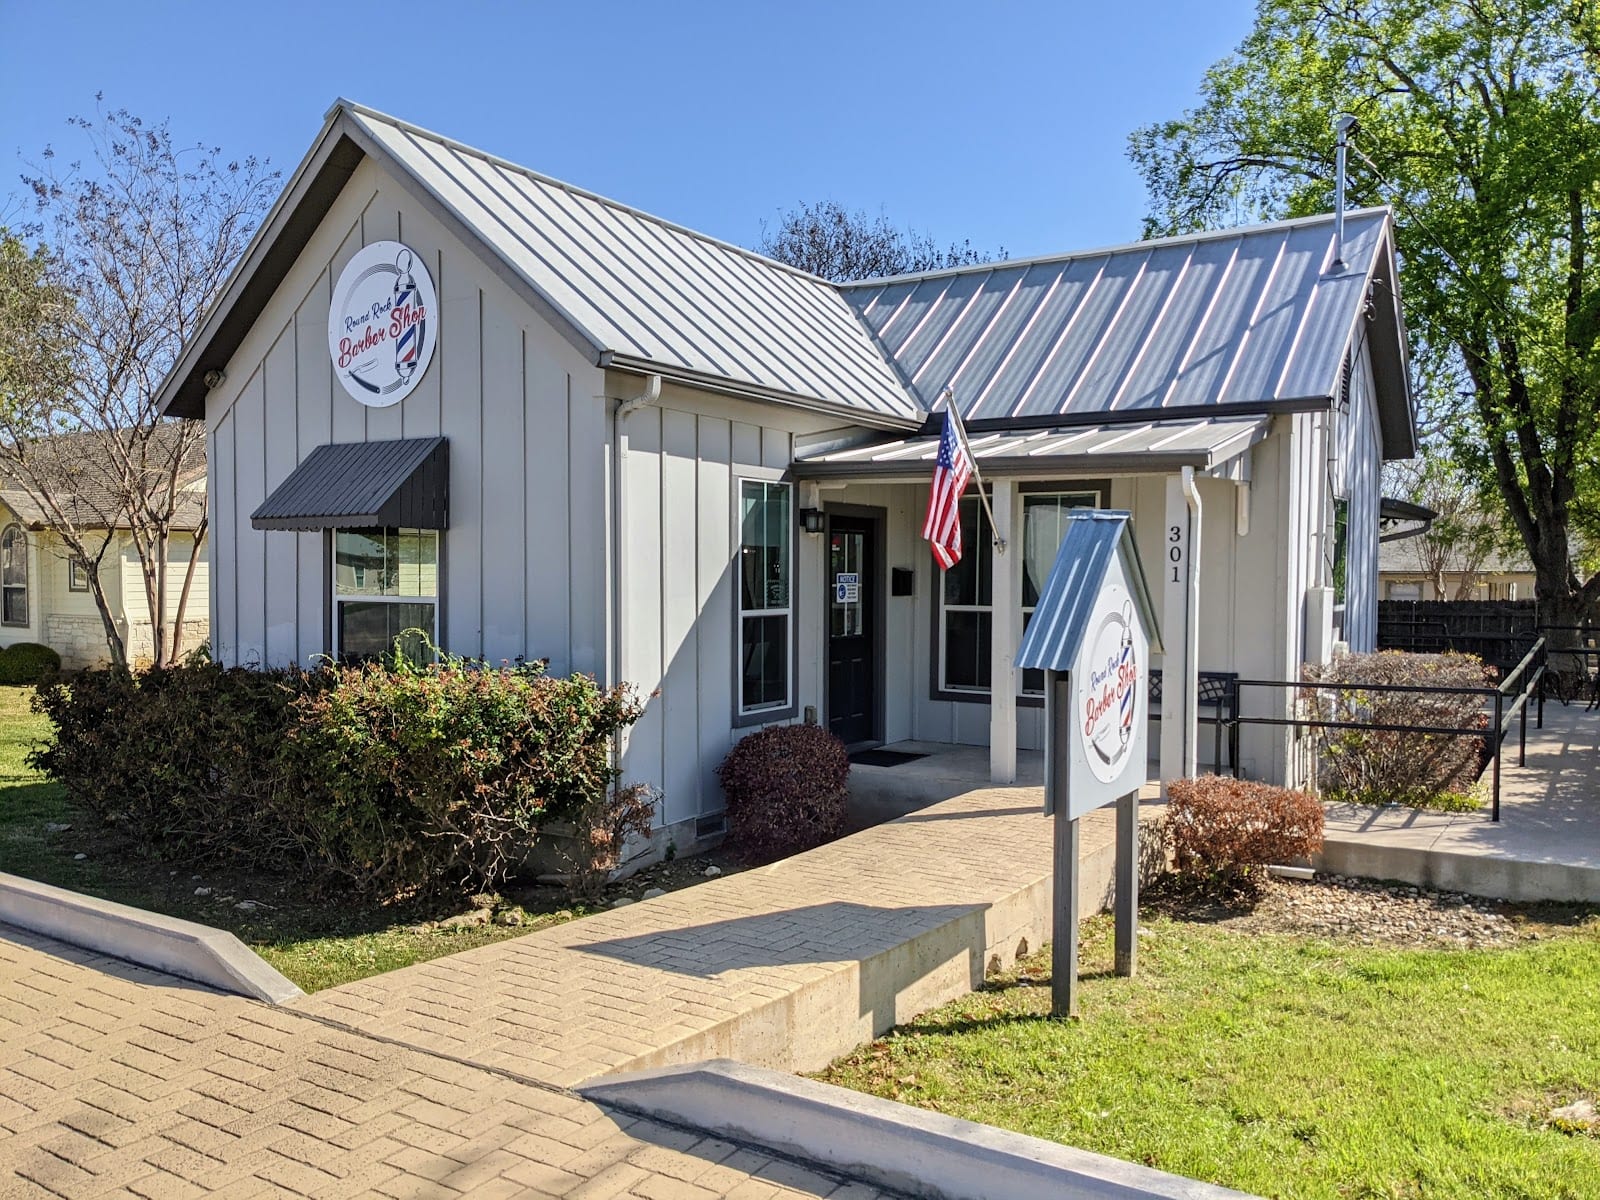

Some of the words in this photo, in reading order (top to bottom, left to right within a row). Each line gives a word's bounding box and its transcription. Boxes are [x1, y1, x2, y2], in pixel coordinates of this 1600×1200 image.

[338, 325, 386, 368] Barber
[388, 303, 427, 339] Shop
[345, 311, 370, 333] Round
[371, 297, 392, 319] Rock
[1169, 526, 1181, 583] 301
[839, 575, 856, 583] NOTICE
[1091, 667, 1107, 691] Round
[1107, 653, 1120, 680] Rock
[1085, 684, 1115, 737] Barber
[1117, 663, 1137, 699] Shop
